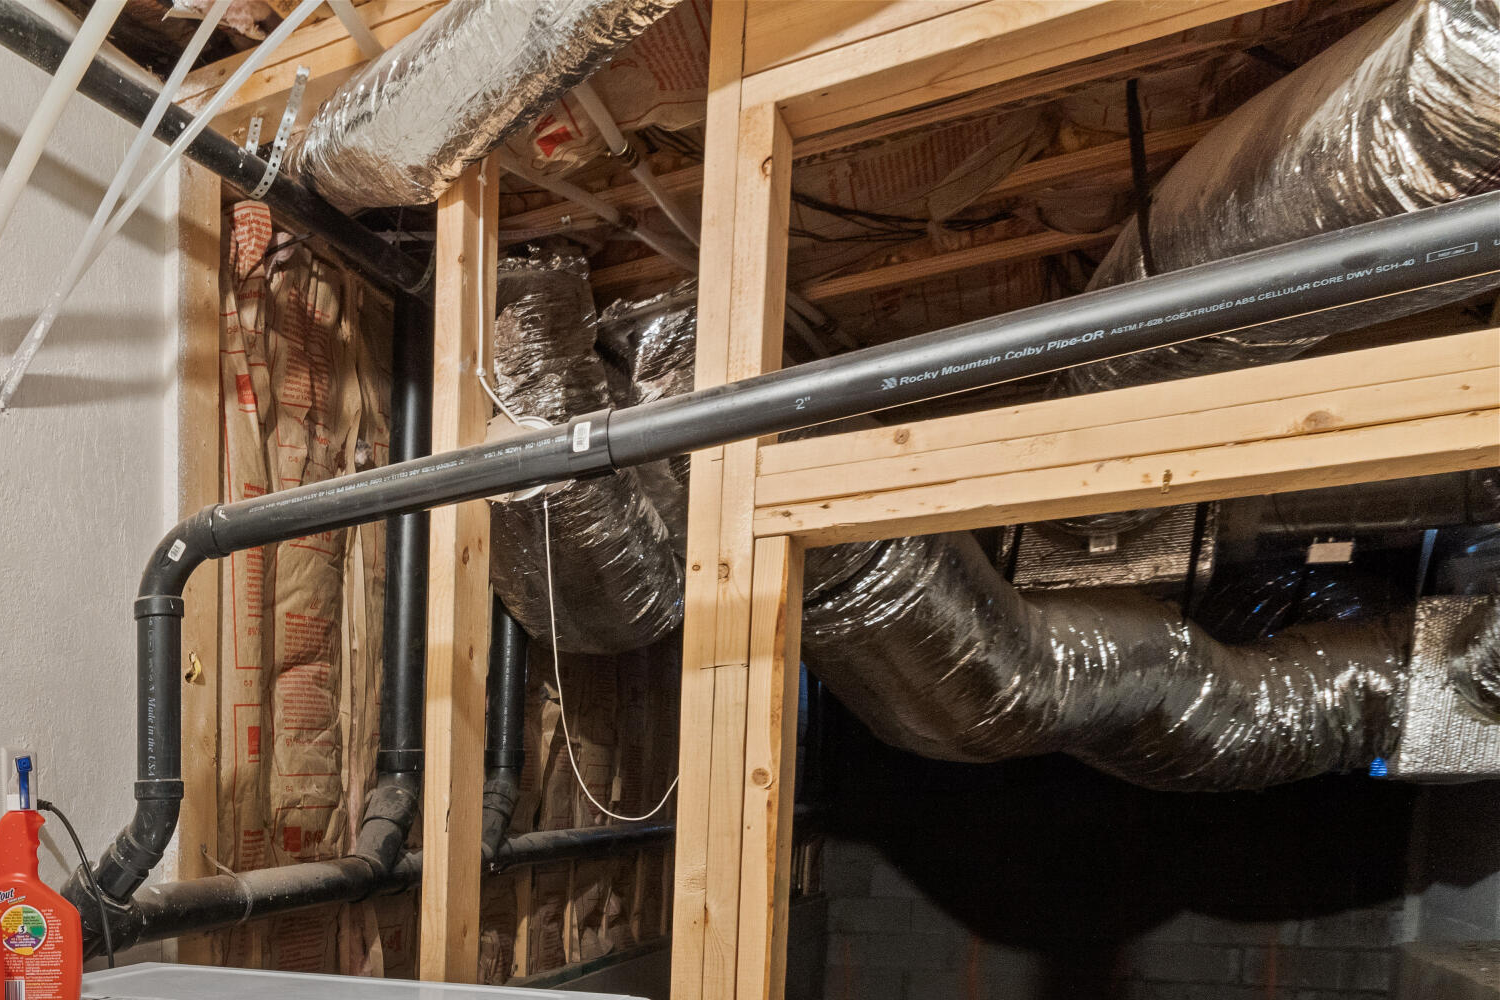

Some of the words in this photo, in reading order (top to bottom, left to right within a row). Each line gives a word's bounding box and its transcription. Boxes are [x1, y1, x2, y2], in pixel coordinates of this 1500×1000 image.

[795, 396, 811, 410] 2"
[900, 370, 939, 385] Rocky
[941, 355, 1000, 376] Mountain
[1004, 345, 1043, 361] Colby
[1047, 330, 1105, 351] Pipe-OR
[1110, 325, 1137, 335] ASTM
[1165, 301, 1234, 324] COEXTRUDED
[1235, 297, 1255, 307] ABS
[1257, 283, 1310, 302] CELLULAR
[1312, 275, 1343, 288] CORE
[1345, 268, 1372, 281] DWV
[1375, 258, 1415, 274] SCH-40
[148, 697, 156, 724] Made
[148, 725, 156, 737] in
[148, 738, 156, 753] the
[148, 754, 156, 776] USA
